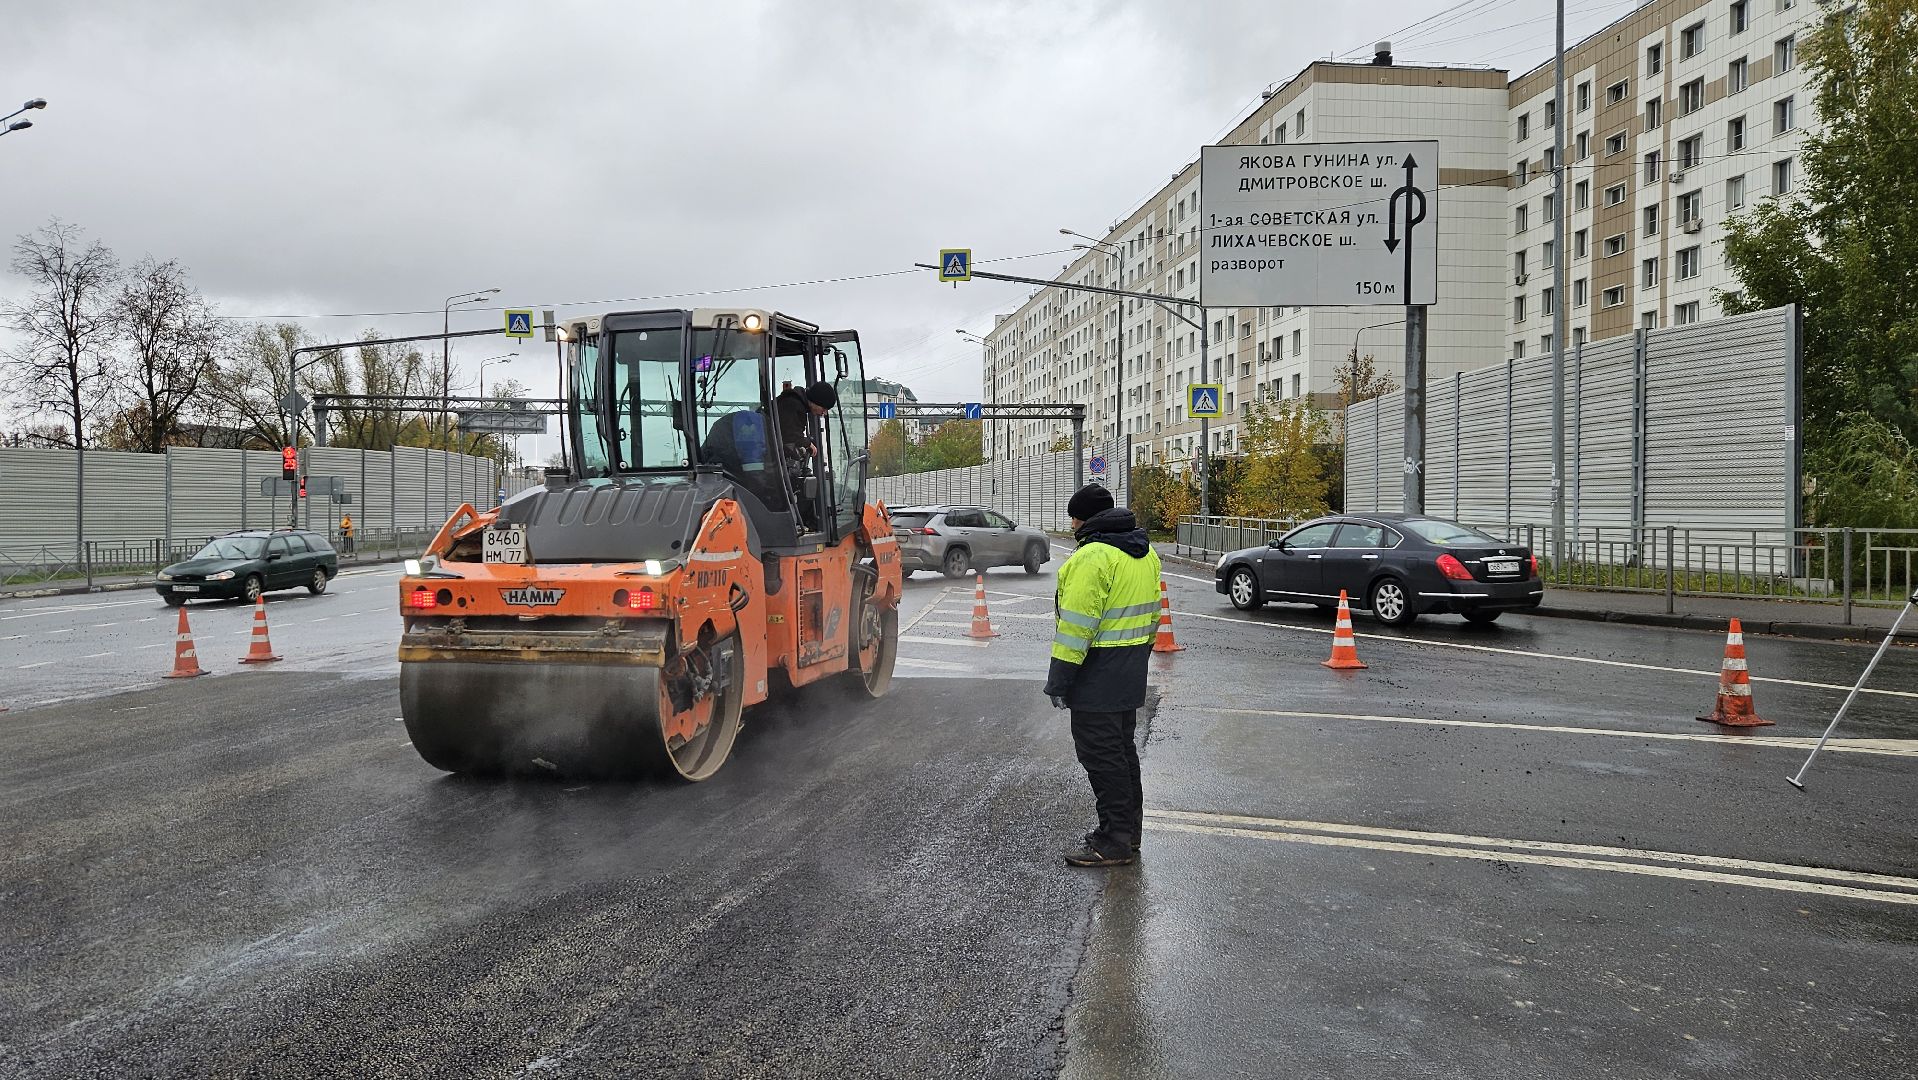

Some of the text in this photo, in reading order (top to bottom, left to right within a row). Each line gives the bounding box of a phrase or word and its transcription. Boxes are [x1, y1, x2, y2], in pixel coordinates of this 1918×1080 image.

[1238, 153, 1398, 169] ЯКОВА ГУНИНА ул.
[1238, 175, 1387, 192] ДМИТРОВСКОЕ ш.
[1210, 211, 1379, 227] 1-ая СОВЕТСКАЯ ул.
[1211, 233, 1357, 248] ЛИХАЧЕВСКОЕ ш.
[1211, 259, 1285, 273] разворот
[487, 531, 520, 546] 8460
[508, 550, 522, 562] 77
[508, 590, 555, 603] HAMM
